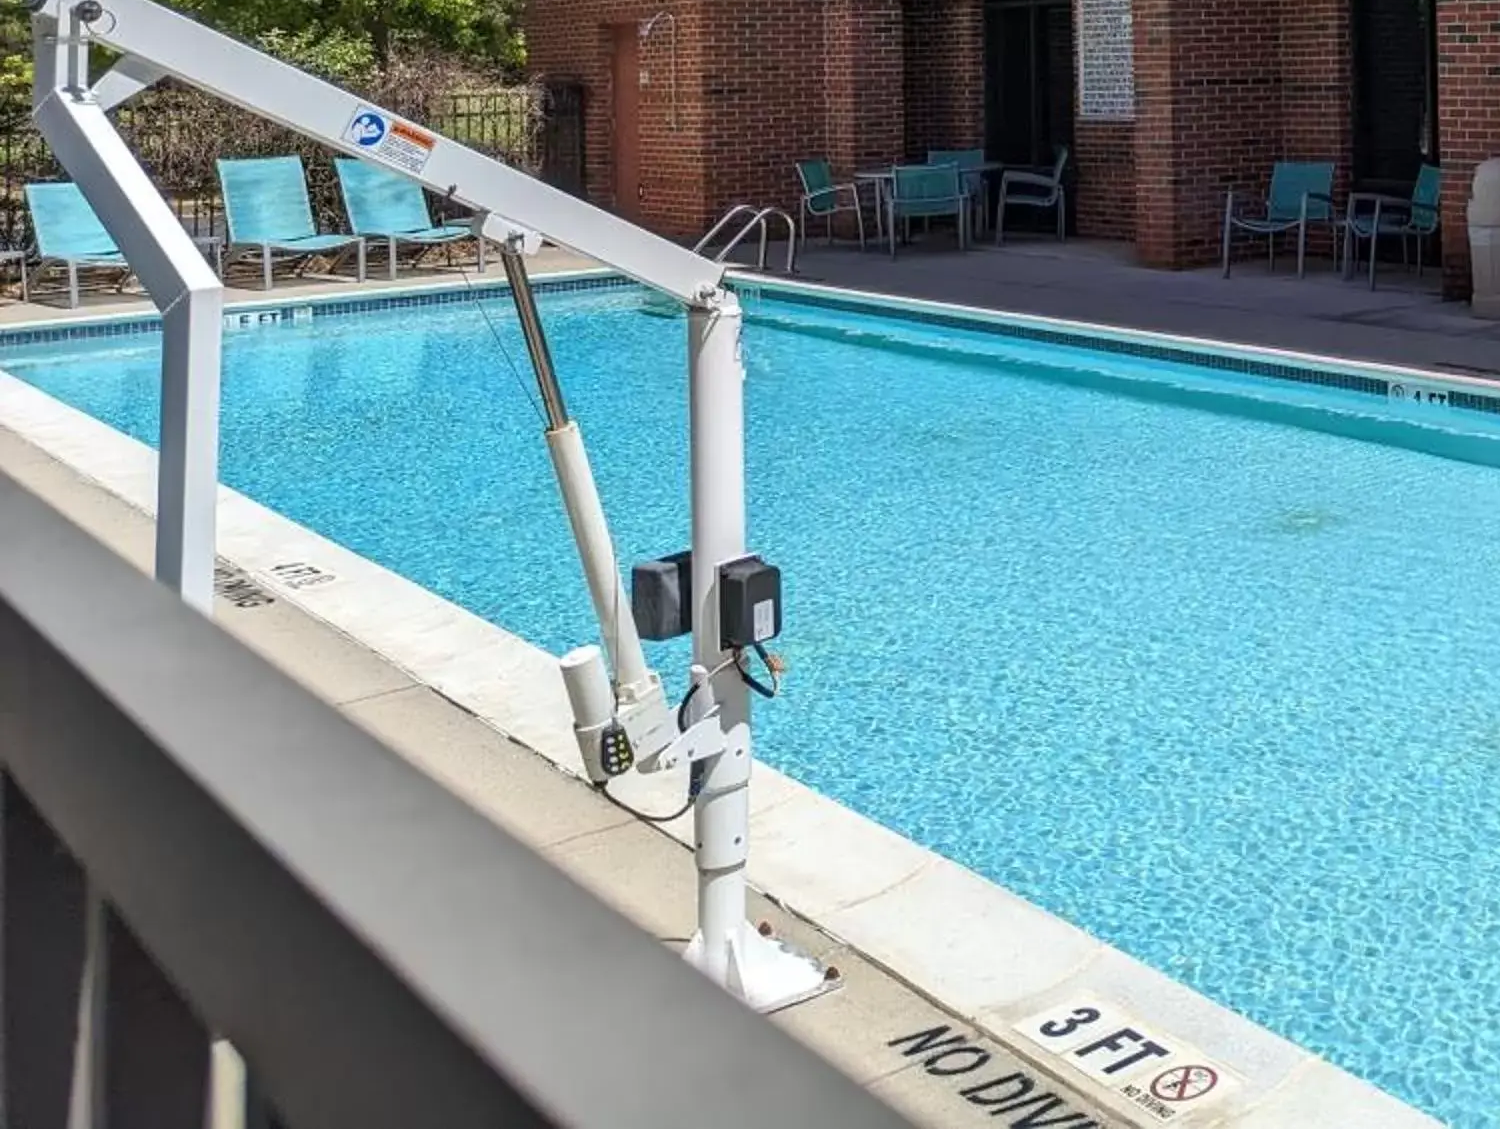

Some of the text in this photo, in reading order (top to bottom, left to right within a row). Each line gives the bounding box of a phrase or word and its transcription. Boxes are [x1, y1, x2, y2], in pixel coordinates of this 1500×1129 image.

[887, 1024, 991, 1076] NO
[1039, 1007, 1172, 1074] 3 FT
